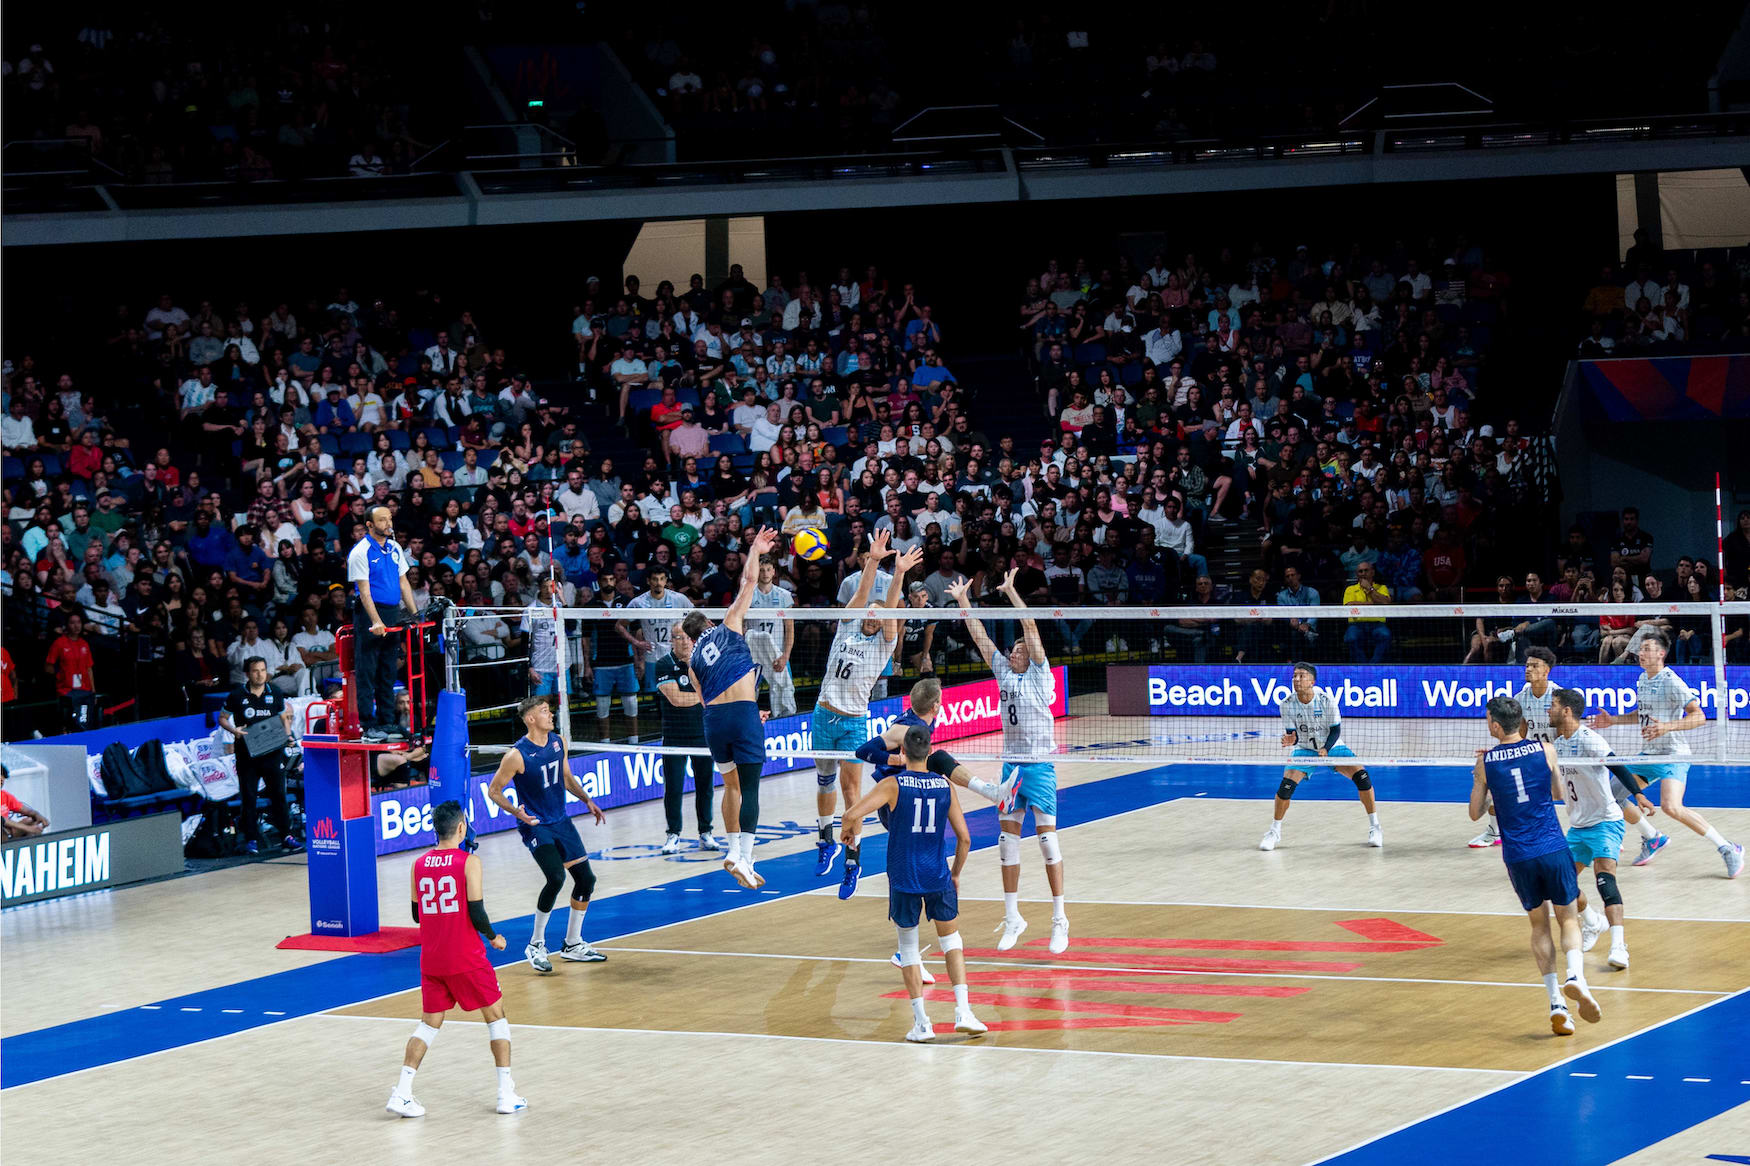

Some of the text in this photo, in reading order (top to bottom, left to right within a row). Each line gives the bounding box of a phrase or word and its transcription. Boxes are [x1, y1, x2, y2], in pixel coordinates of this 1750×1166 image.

[654, 627, 668, 643] 12
[701, 641, 721, 667] 8
[847, 647, 865, 659] BNA
[835, 658, 854, 680] 16
[1148, 678, 1397, 707] Beach Voyball
[1421, 680, 1513, 708] World
[934, 695, 1001, 728] AXCAL
[1008, 704, 1018, 726] 8
[1485, 741, 1543, 763] ANDERSON
[541, 760, 560, 789] 17
[897, 775, 950, 789] CHRISTENSON
[1511, 767, 1530, 804] 1
[1567, 780, 1578, 802] 3
[911, 797, 937, 833] 11
[419, 875, 460, 915] 22
